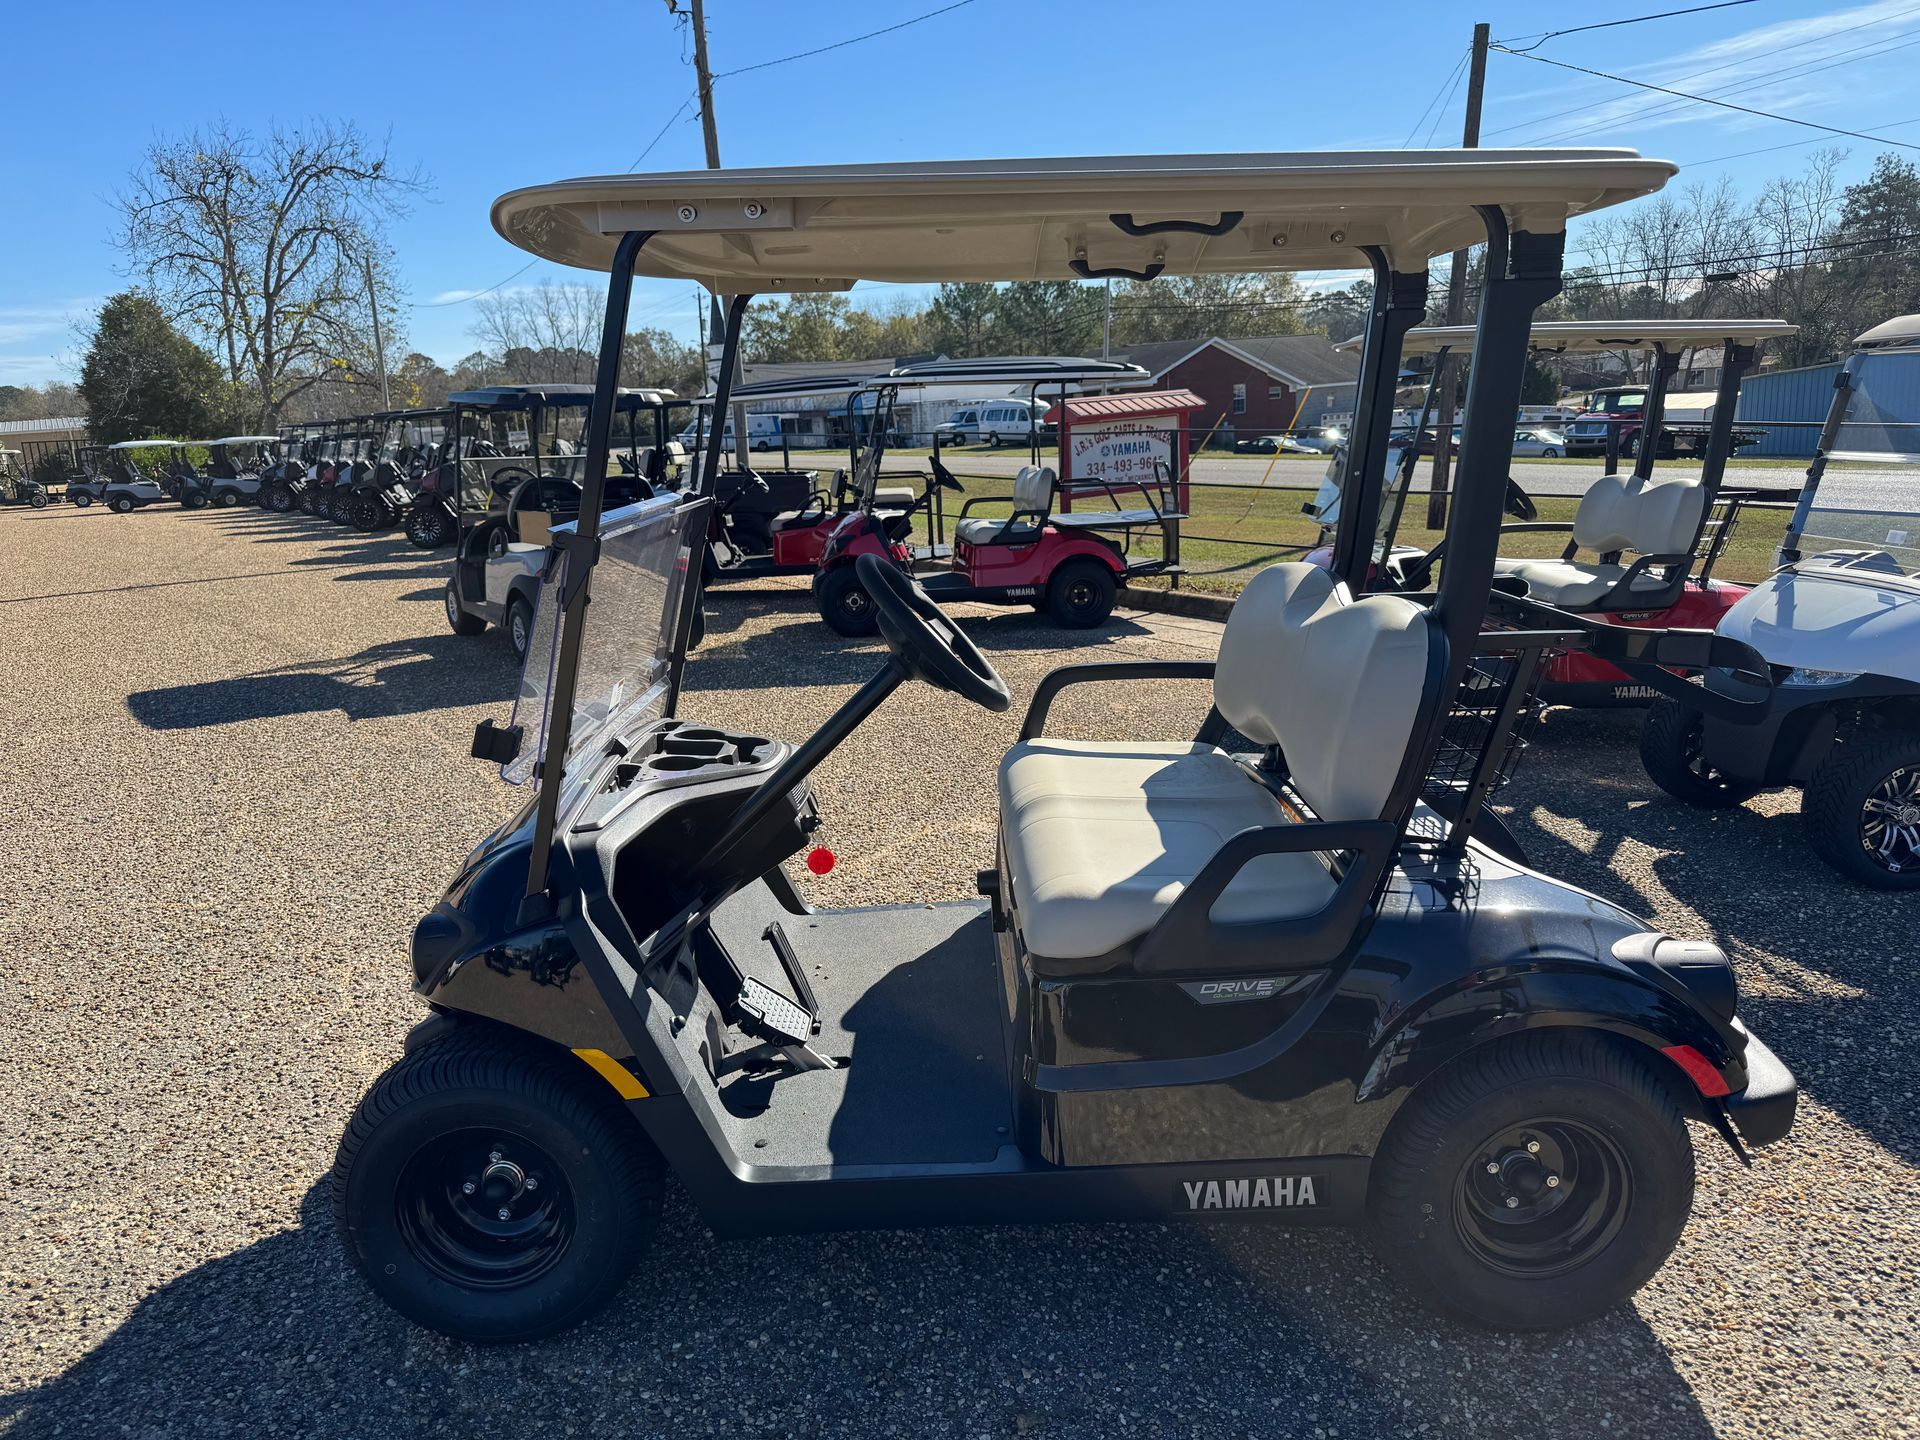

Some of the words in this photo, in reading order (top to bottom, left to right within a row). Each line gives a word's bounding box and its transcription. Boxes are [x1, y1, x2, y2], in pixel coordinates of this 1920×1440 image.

[1094, 426, 1112, 444] GOLF
[1113, 423, 1136, 438] CARTS
[1138, 424, 1143, 437] &
[1145, 425, 1172, 447] TRAILER
[1111, 440, 1151, 456] YAMAHA
[1006, 587, 1036, 597] YAMAHA
[1183, 1176, 1317, 1210] YAMAHA
